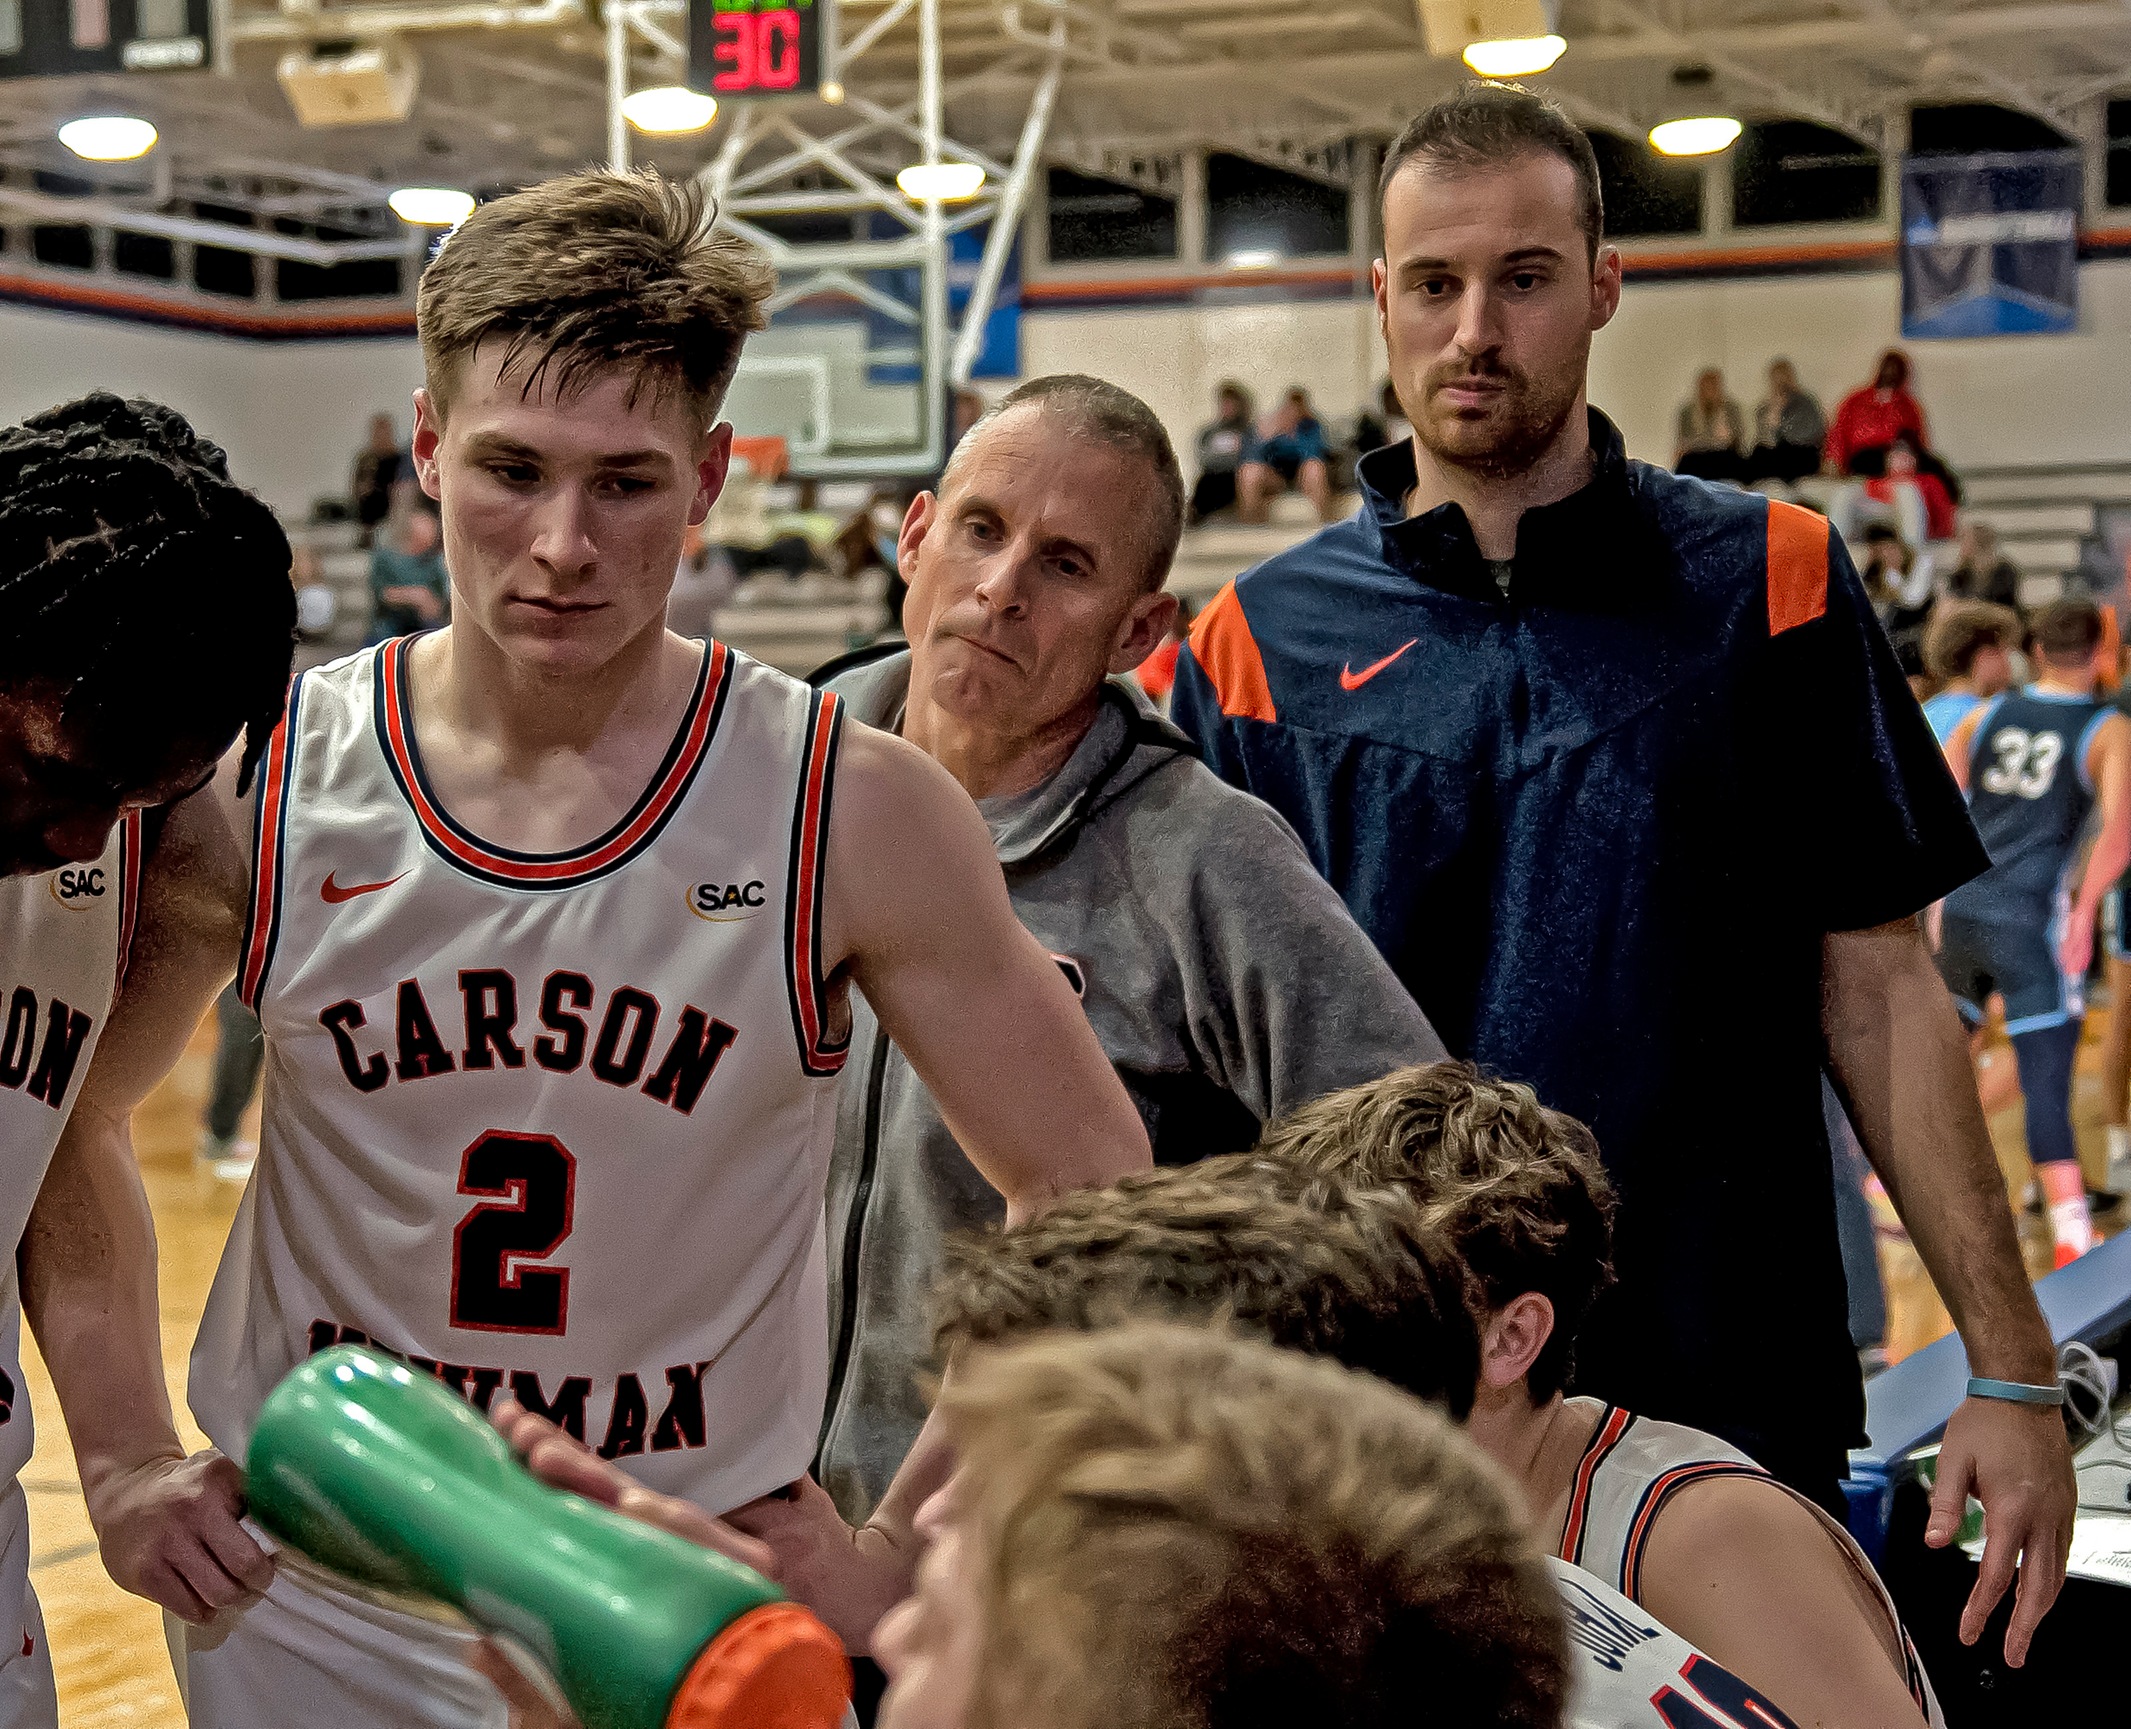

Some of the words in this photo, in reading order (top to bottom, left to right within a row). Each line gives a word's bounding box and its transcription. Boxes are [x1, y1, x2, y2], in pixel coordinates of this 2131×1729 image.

[711, 8, 799, 91] 30
[1981, 725, 2065, 799] 33
[59, 868, 106, 899] SAC
[696, 880, 766, 911] SAC
[0, 984, 94, 1112] ON
[318, 968, 740, 1117] CARSON
[449, 1128, 577, 1337] 2
